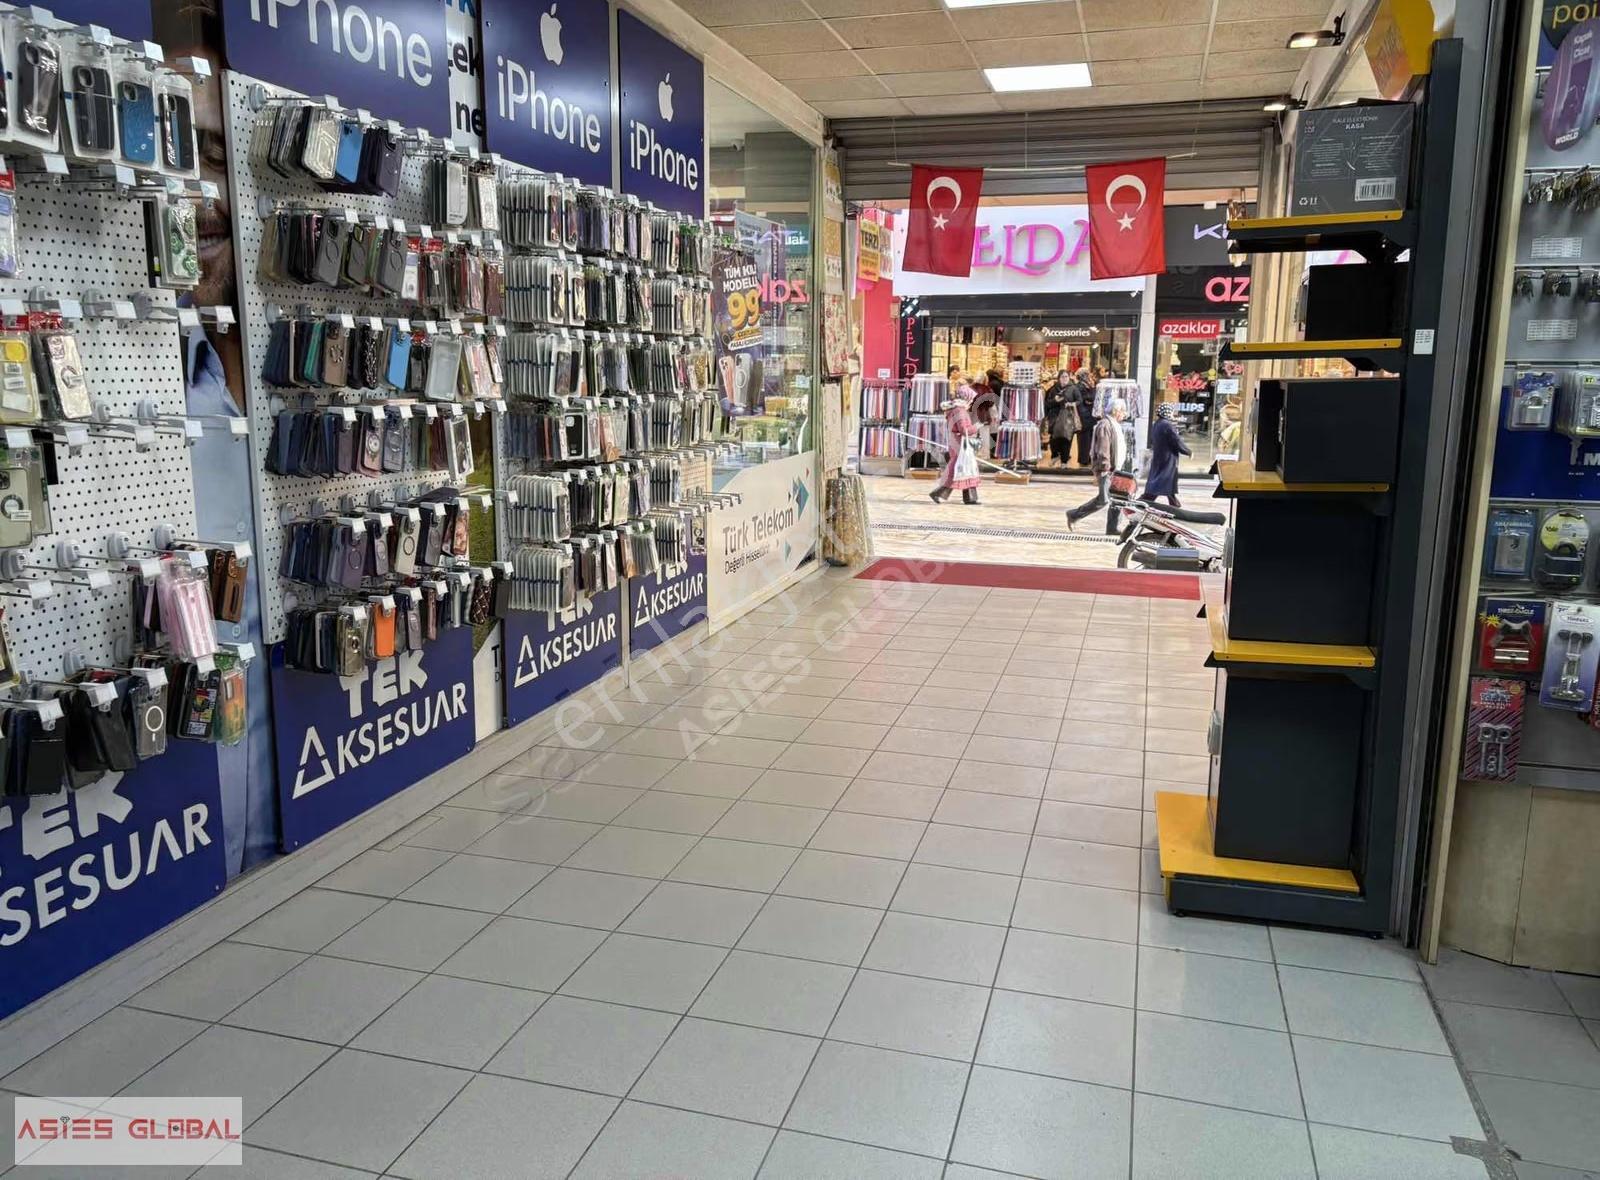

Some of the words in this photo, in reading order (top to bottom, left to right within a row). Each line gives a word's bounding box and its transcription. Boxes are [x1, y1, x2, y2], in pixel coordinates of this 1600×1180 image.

[250, 0, 433, 87] hone
[497, 55, 601, 153] iPhone
[1345, 122, 1365, 130] KASA
[629, 119, 698, 191] iPhone
[723, 265, 741, 280] TÜM
[971, 218, 1091, 277] ELDA
[727, 288, 760, 329] 99
[1205, 276, 1251, 303] az
[1043, 327, 1091, 338] Accessories
[1161, 321, 1217, 335] azaklar
[723, 521, 749, 556] Türk
[752, 507, 794, 542] Telekom
[634, 572, 704, 629] AKSESUAR
[513, 612, 617, 688] AKSESUAR
[339, 650, 428, 719] TEK
[292, 682, 468, 800] AKSESUAR
[0, 769, 133, 861] EK
[0, 803, 211, 946] SESUAR
